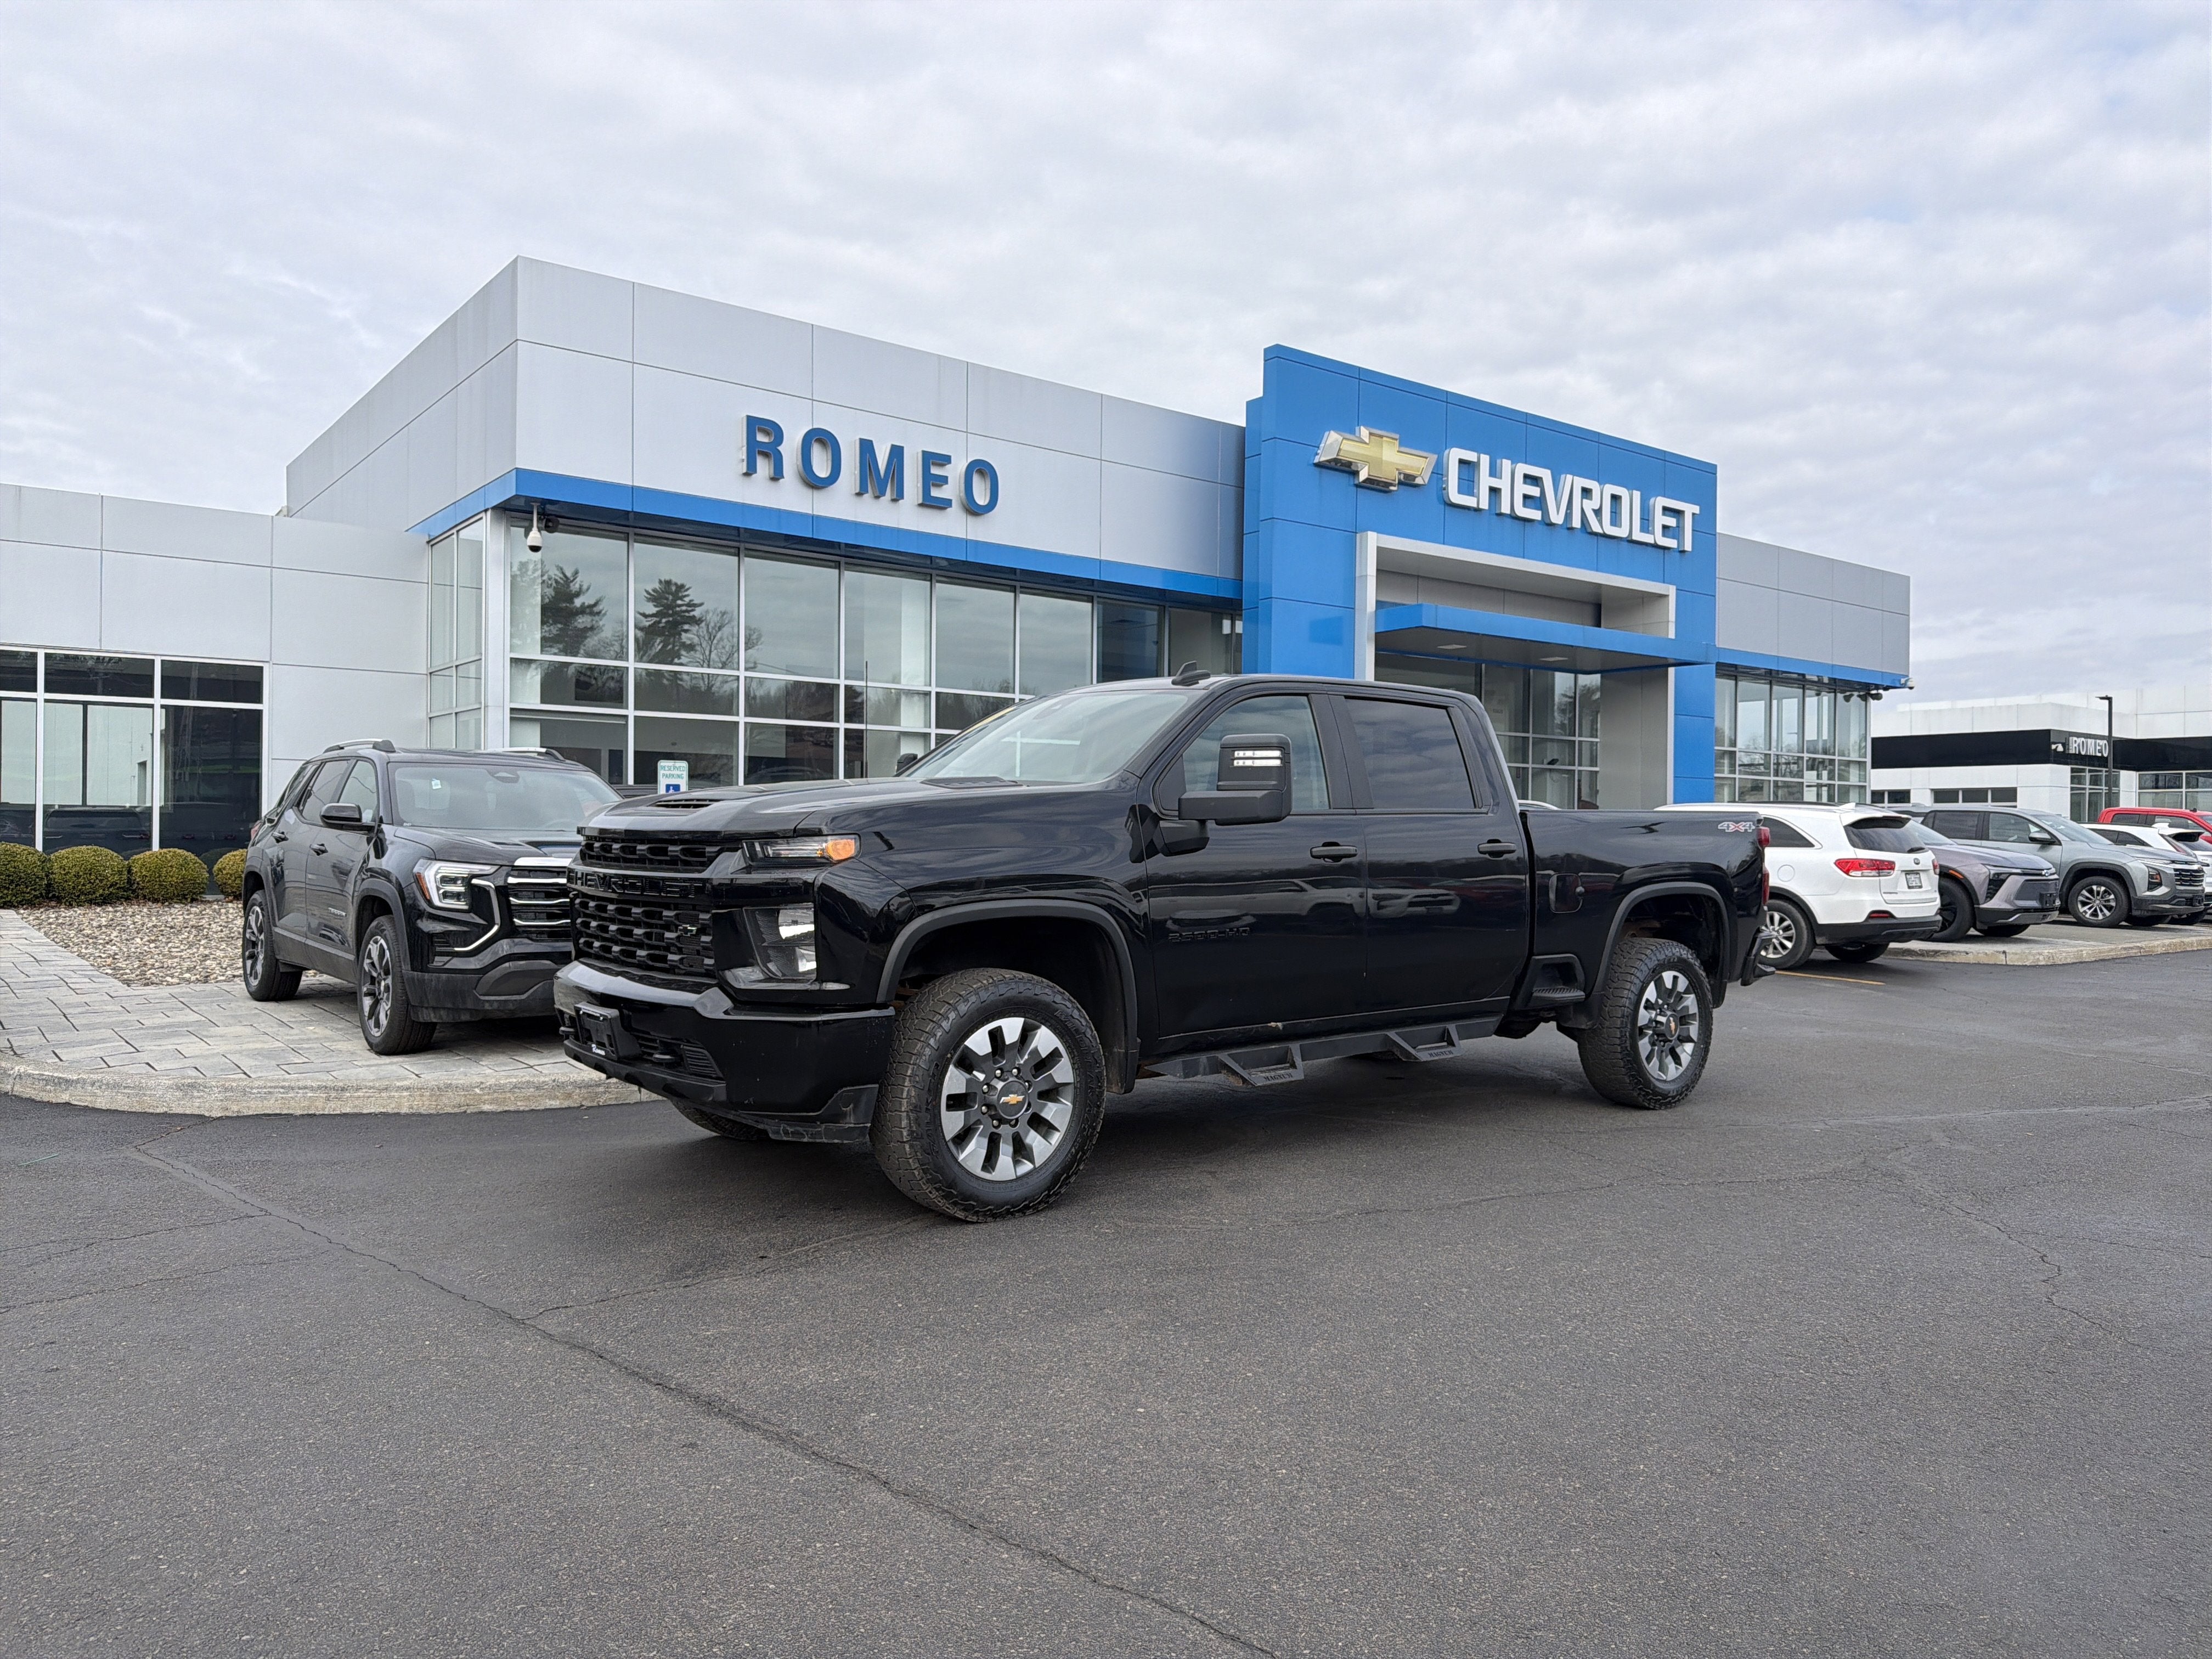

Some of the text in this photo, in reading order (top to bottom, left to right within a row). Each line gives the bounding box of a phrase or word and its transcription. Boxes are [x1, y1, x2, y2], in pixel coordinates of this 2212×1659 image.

[742, 414, 999, 515] ROMEO
[1443, 447, 1700, 552] CHEVROLET
[2069, 737, 2109, 757] ROMEO
[1263, 1073, 1293, 1081] MAGNUM
